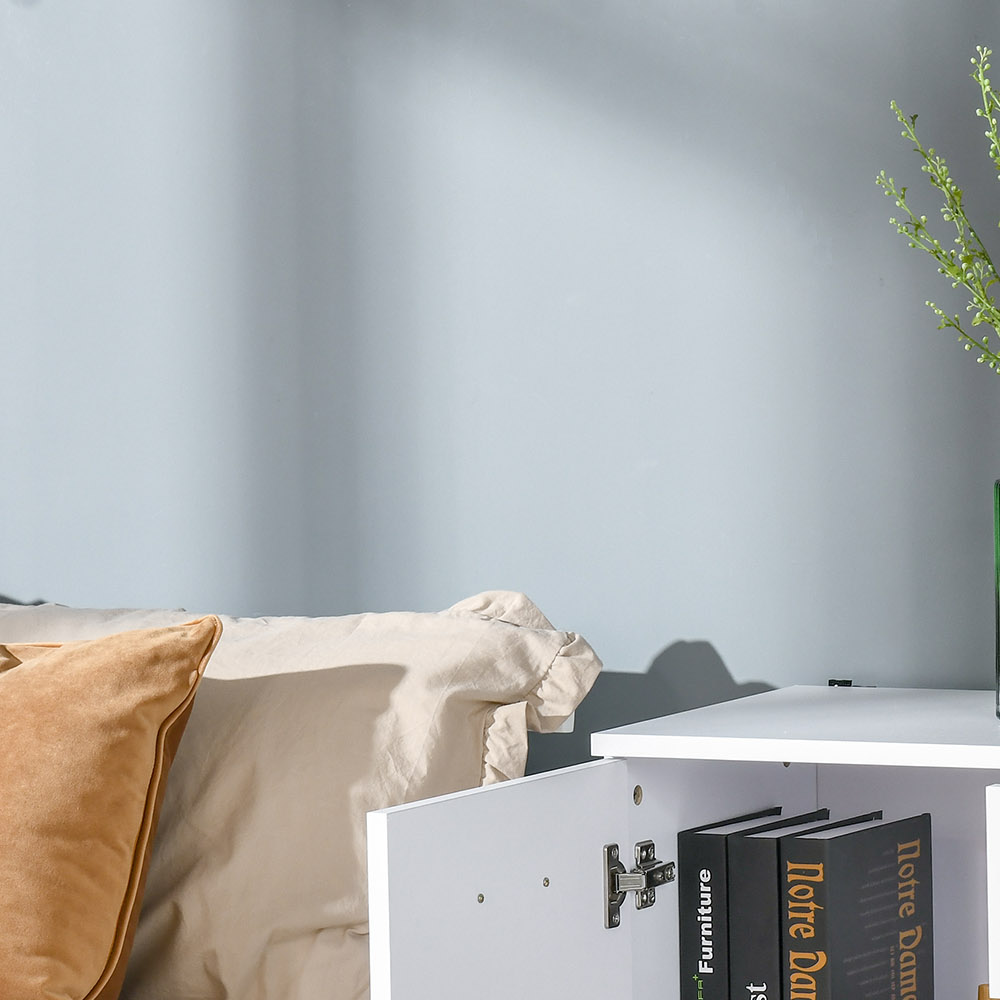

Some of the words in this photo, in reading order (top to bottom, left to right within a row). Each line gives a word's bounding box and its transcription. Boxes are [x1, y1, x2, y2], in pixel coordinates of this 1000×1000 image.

[786, 860, 824, 939] Notre
[897, 838, 921, 918] Notre
[697, 868, 714, 974] Furniture
